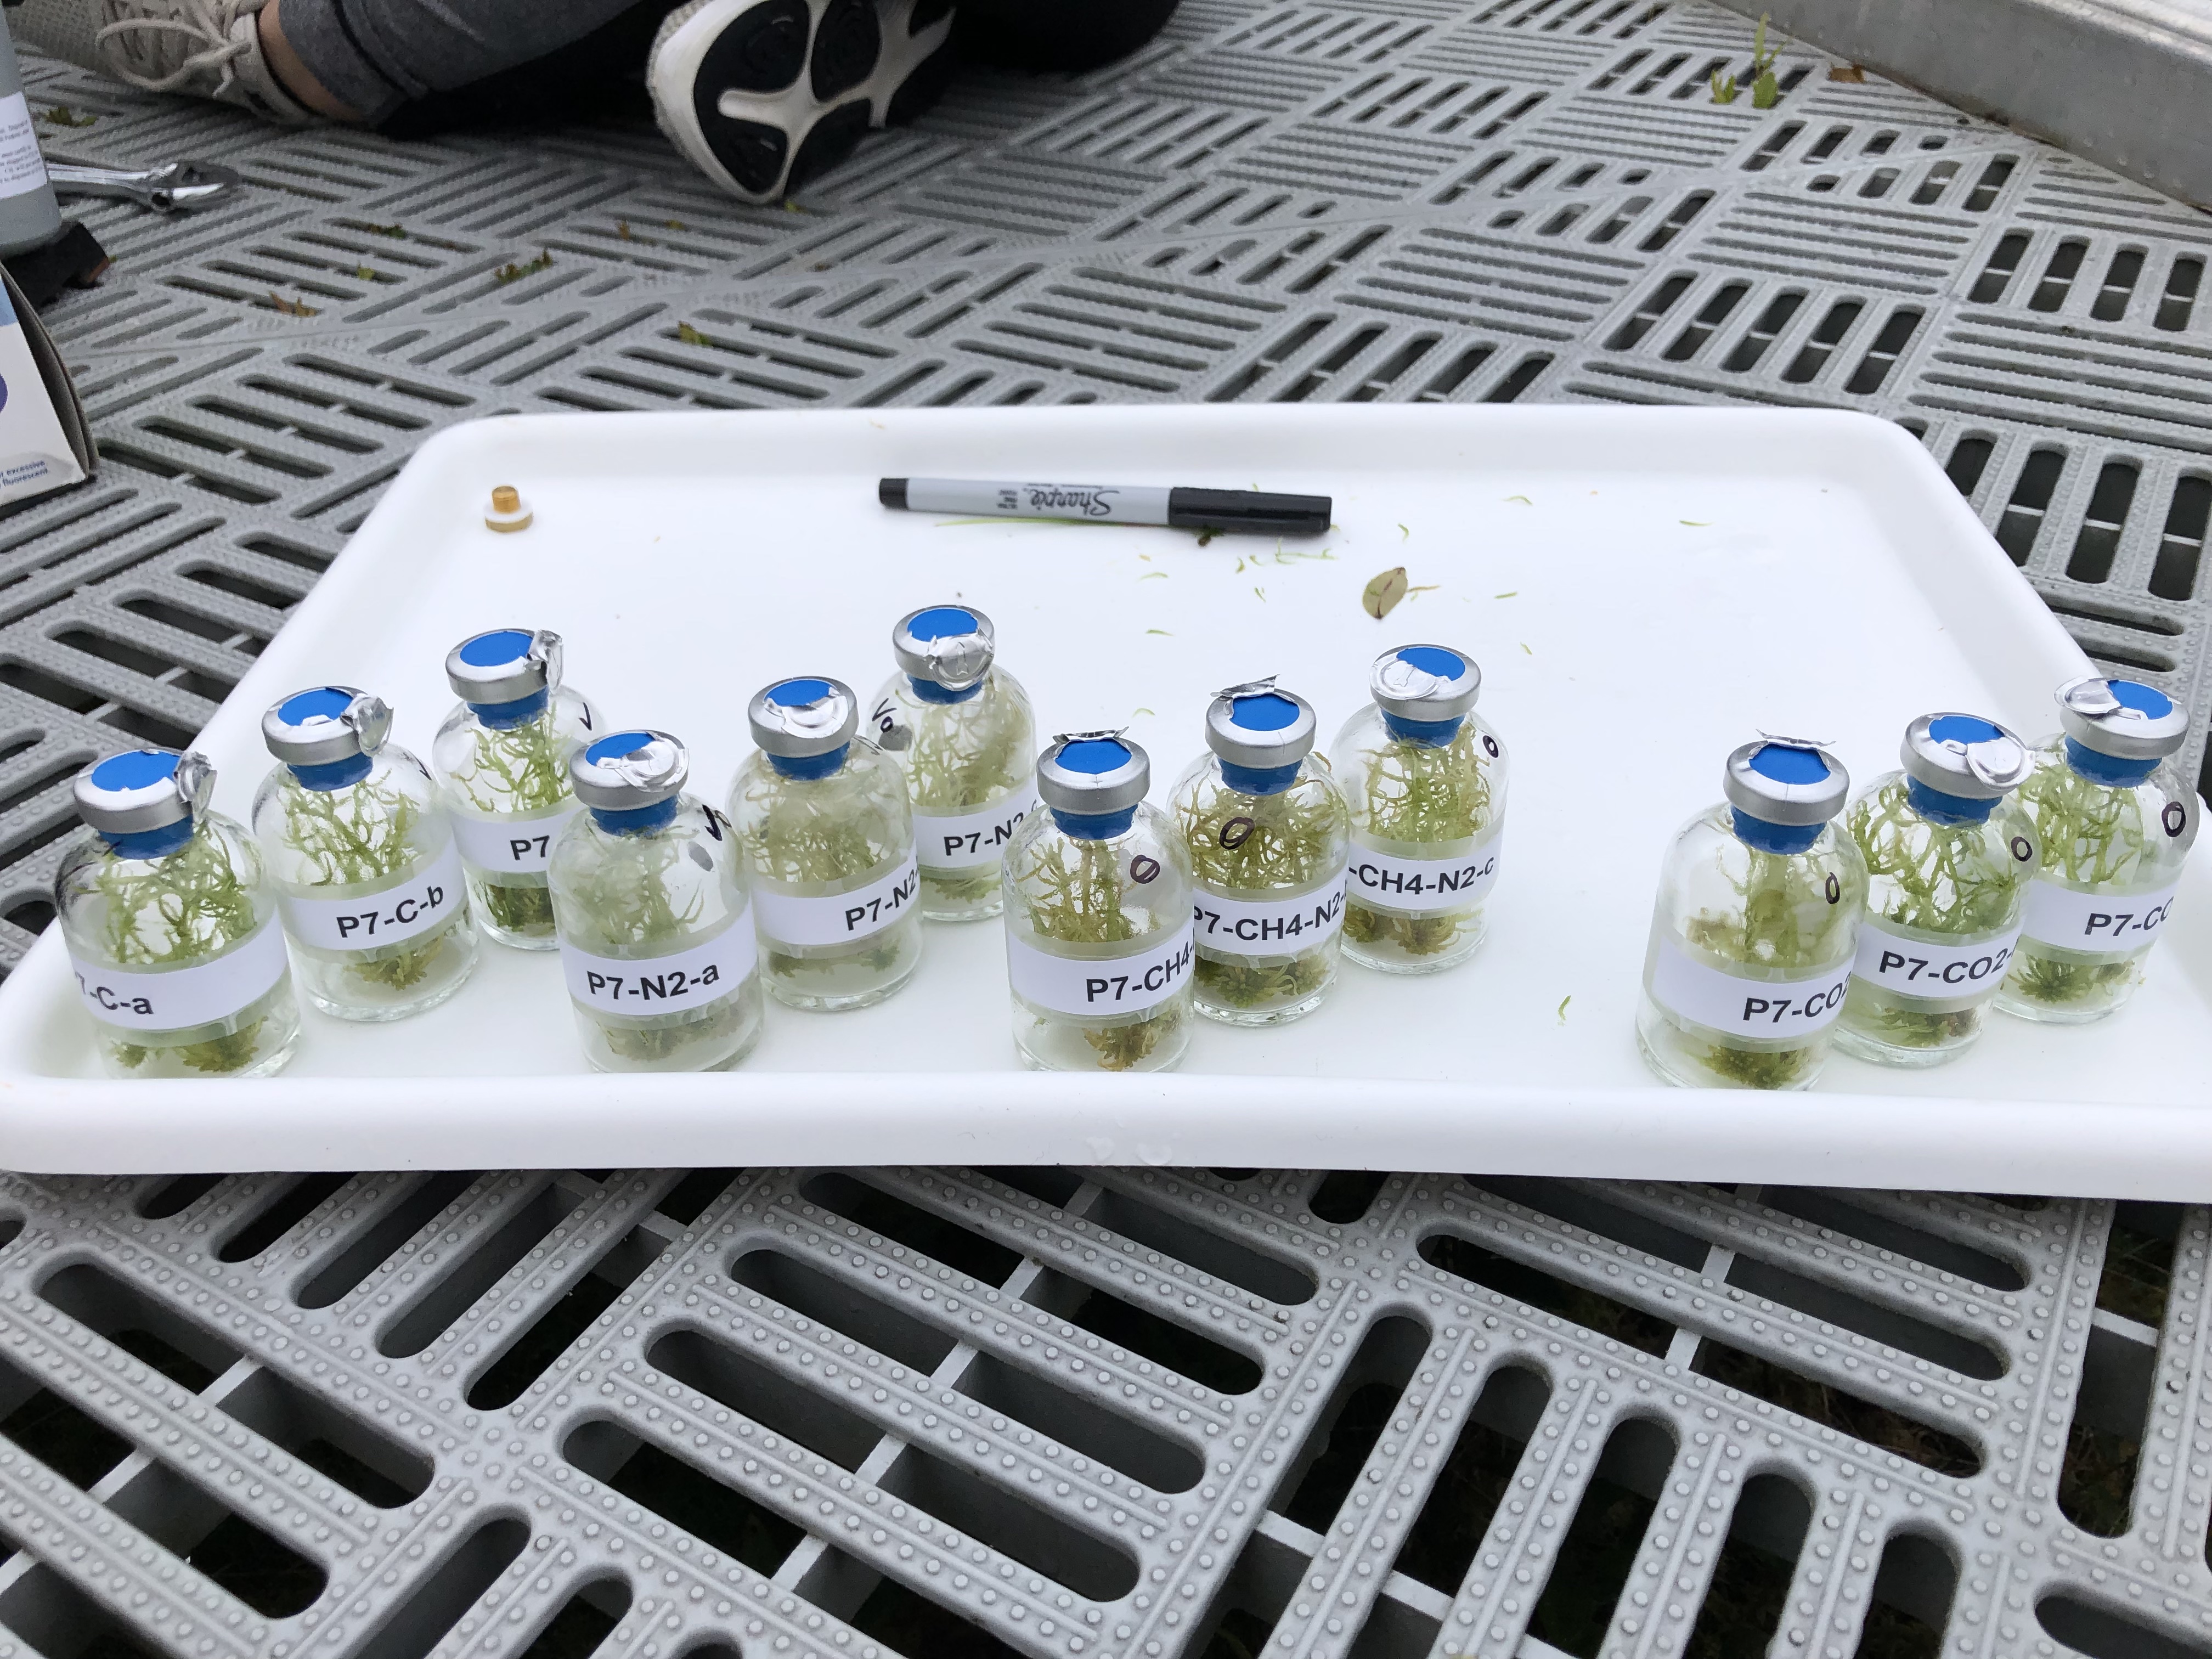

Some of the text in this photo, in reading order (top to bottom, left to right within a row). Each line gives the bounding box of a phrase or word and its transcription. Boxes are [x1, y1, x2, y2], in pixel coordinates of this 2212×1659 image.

[1029, 488, 1120, 516] Sharpie
[510, 834, 550, 861] P7
[336, 885, 444, 938] P7-C-b
[587, 964, 720, 1001] P7-N2-a
